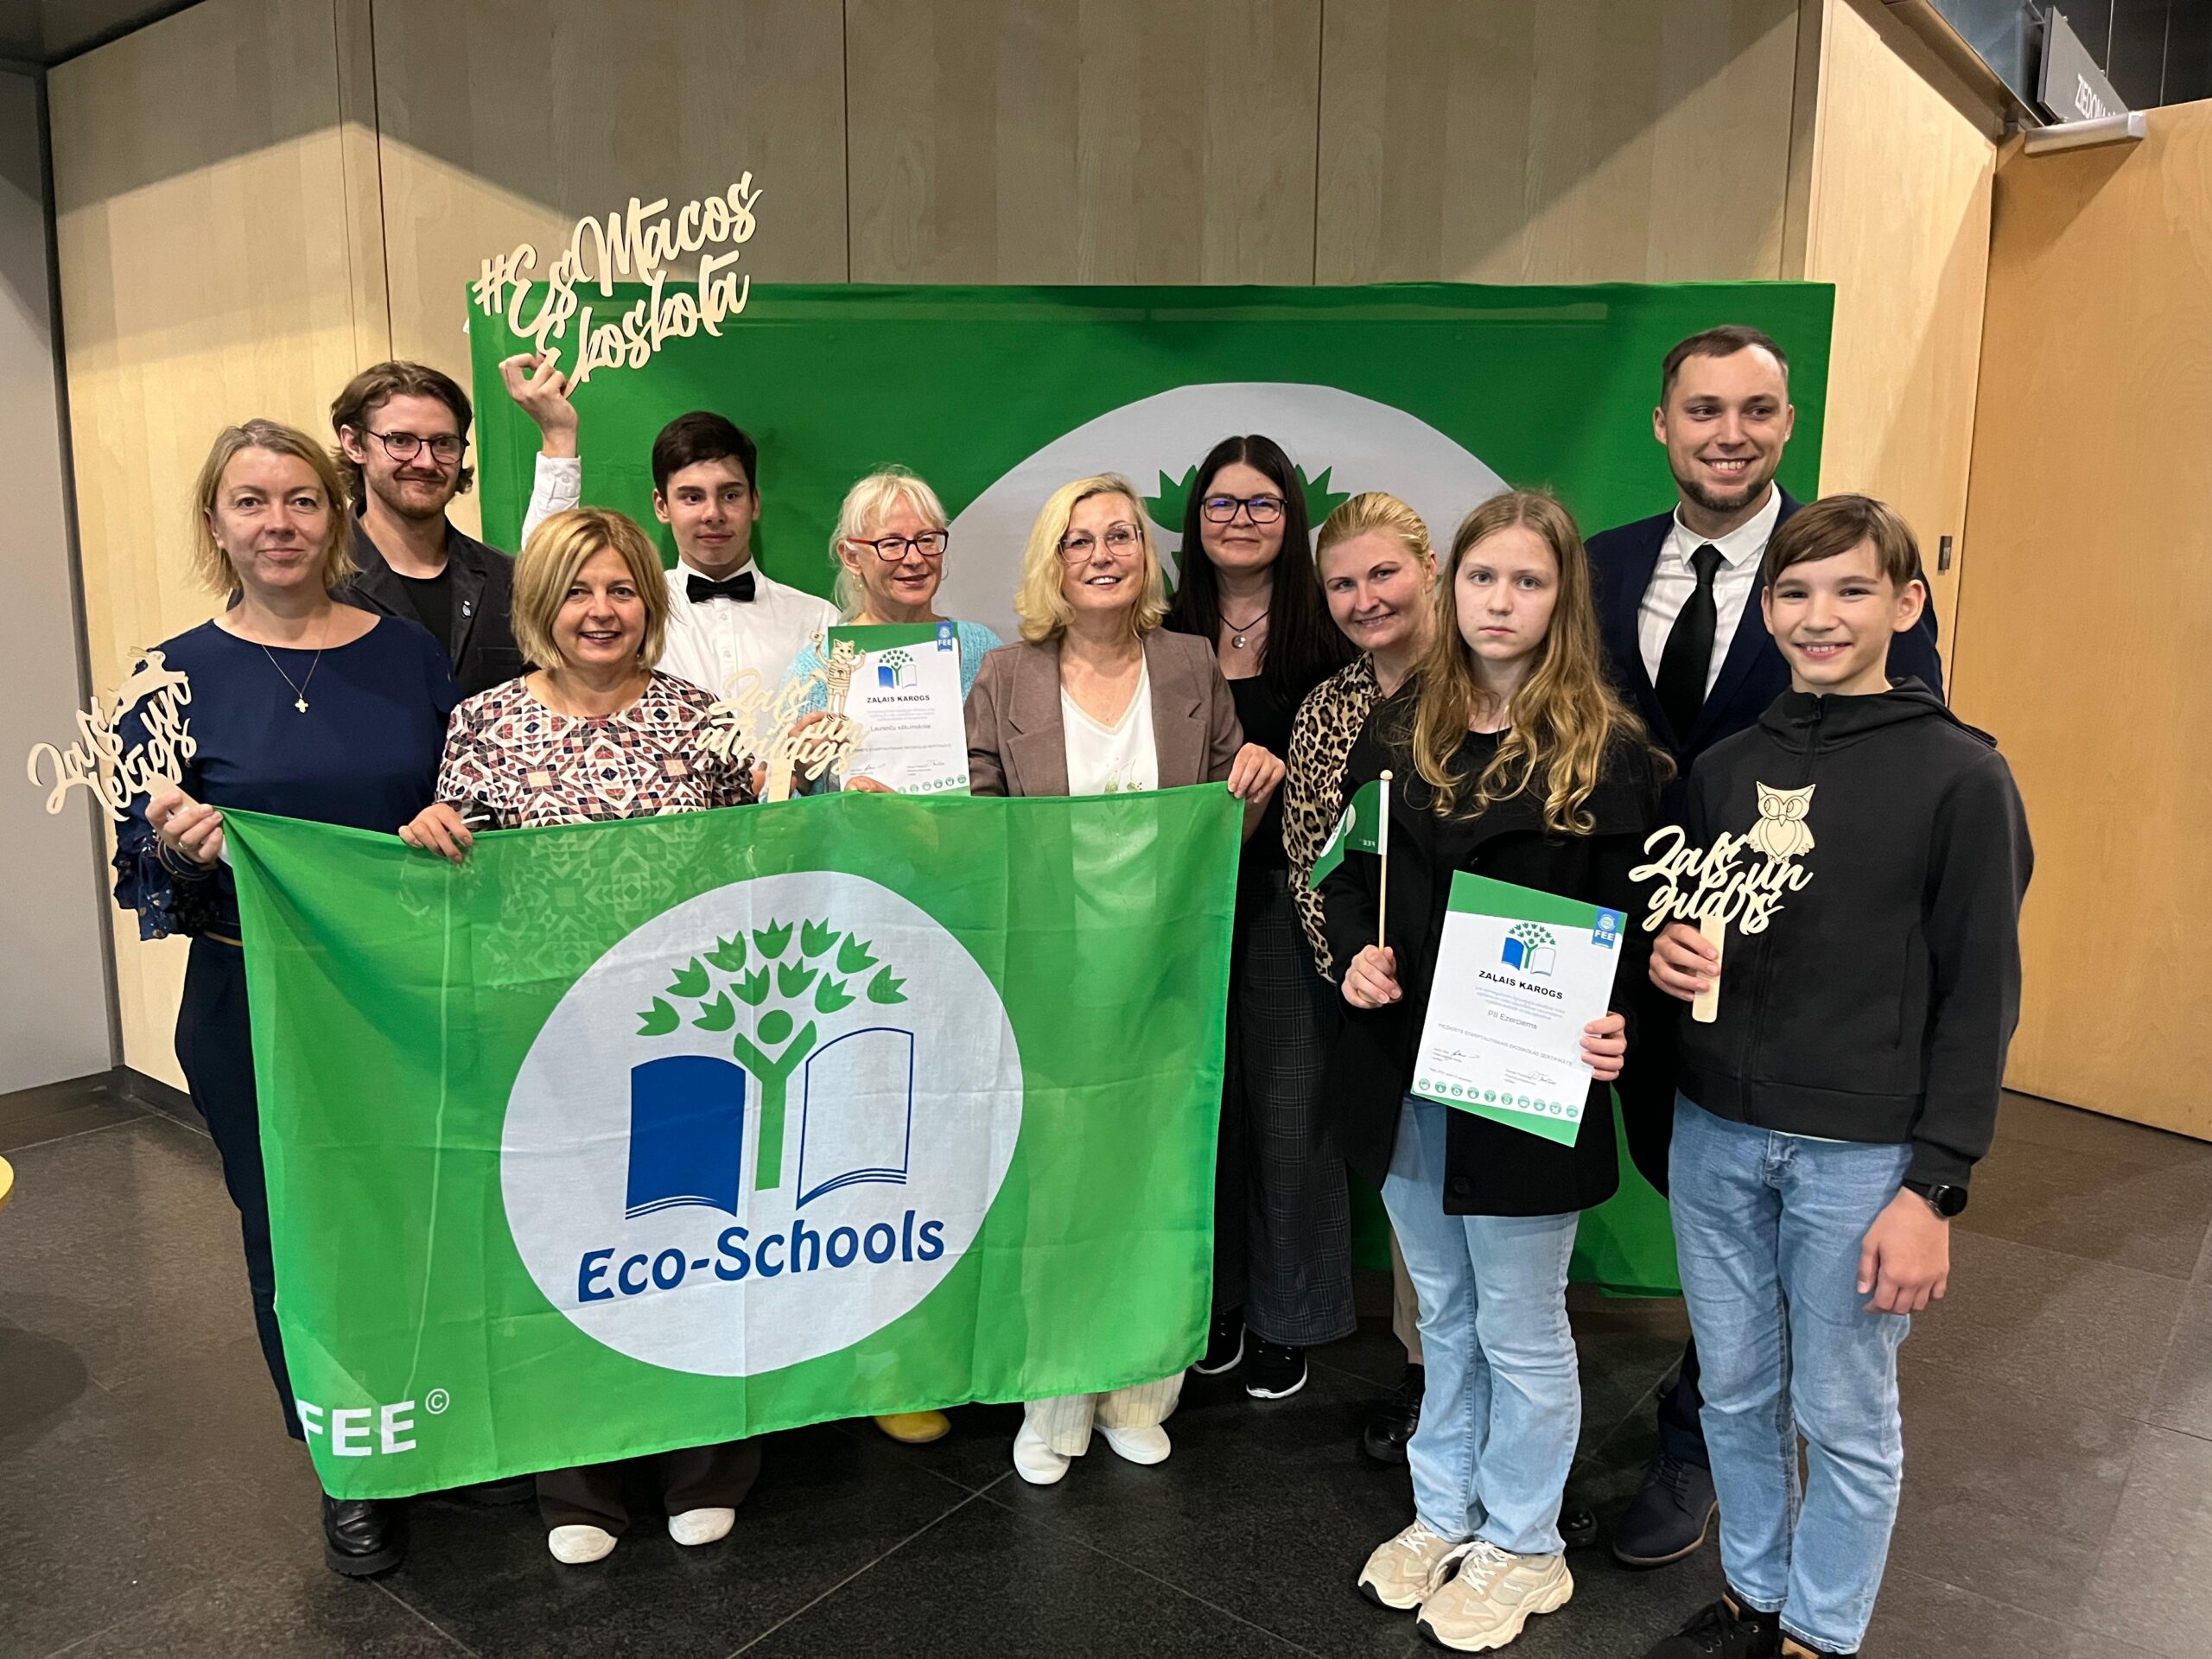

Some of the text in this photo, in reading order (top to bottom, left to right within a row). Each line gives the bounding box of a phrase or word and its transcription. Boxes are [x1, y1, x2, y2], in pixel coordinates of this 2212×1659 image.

[2075, 73, 2107, 119] ZIEDO
[1745, 861, 1814, 892] un
[1594, 929, 1615, 942] FEE
[1478, 970, 1516, 987] ZAĻAIS
[1519, 982, 1563, 1000] KAROGS
[579, 1210, 944, 1302] Eco-Schools
[296, 1398, 416, 1457] FEE
